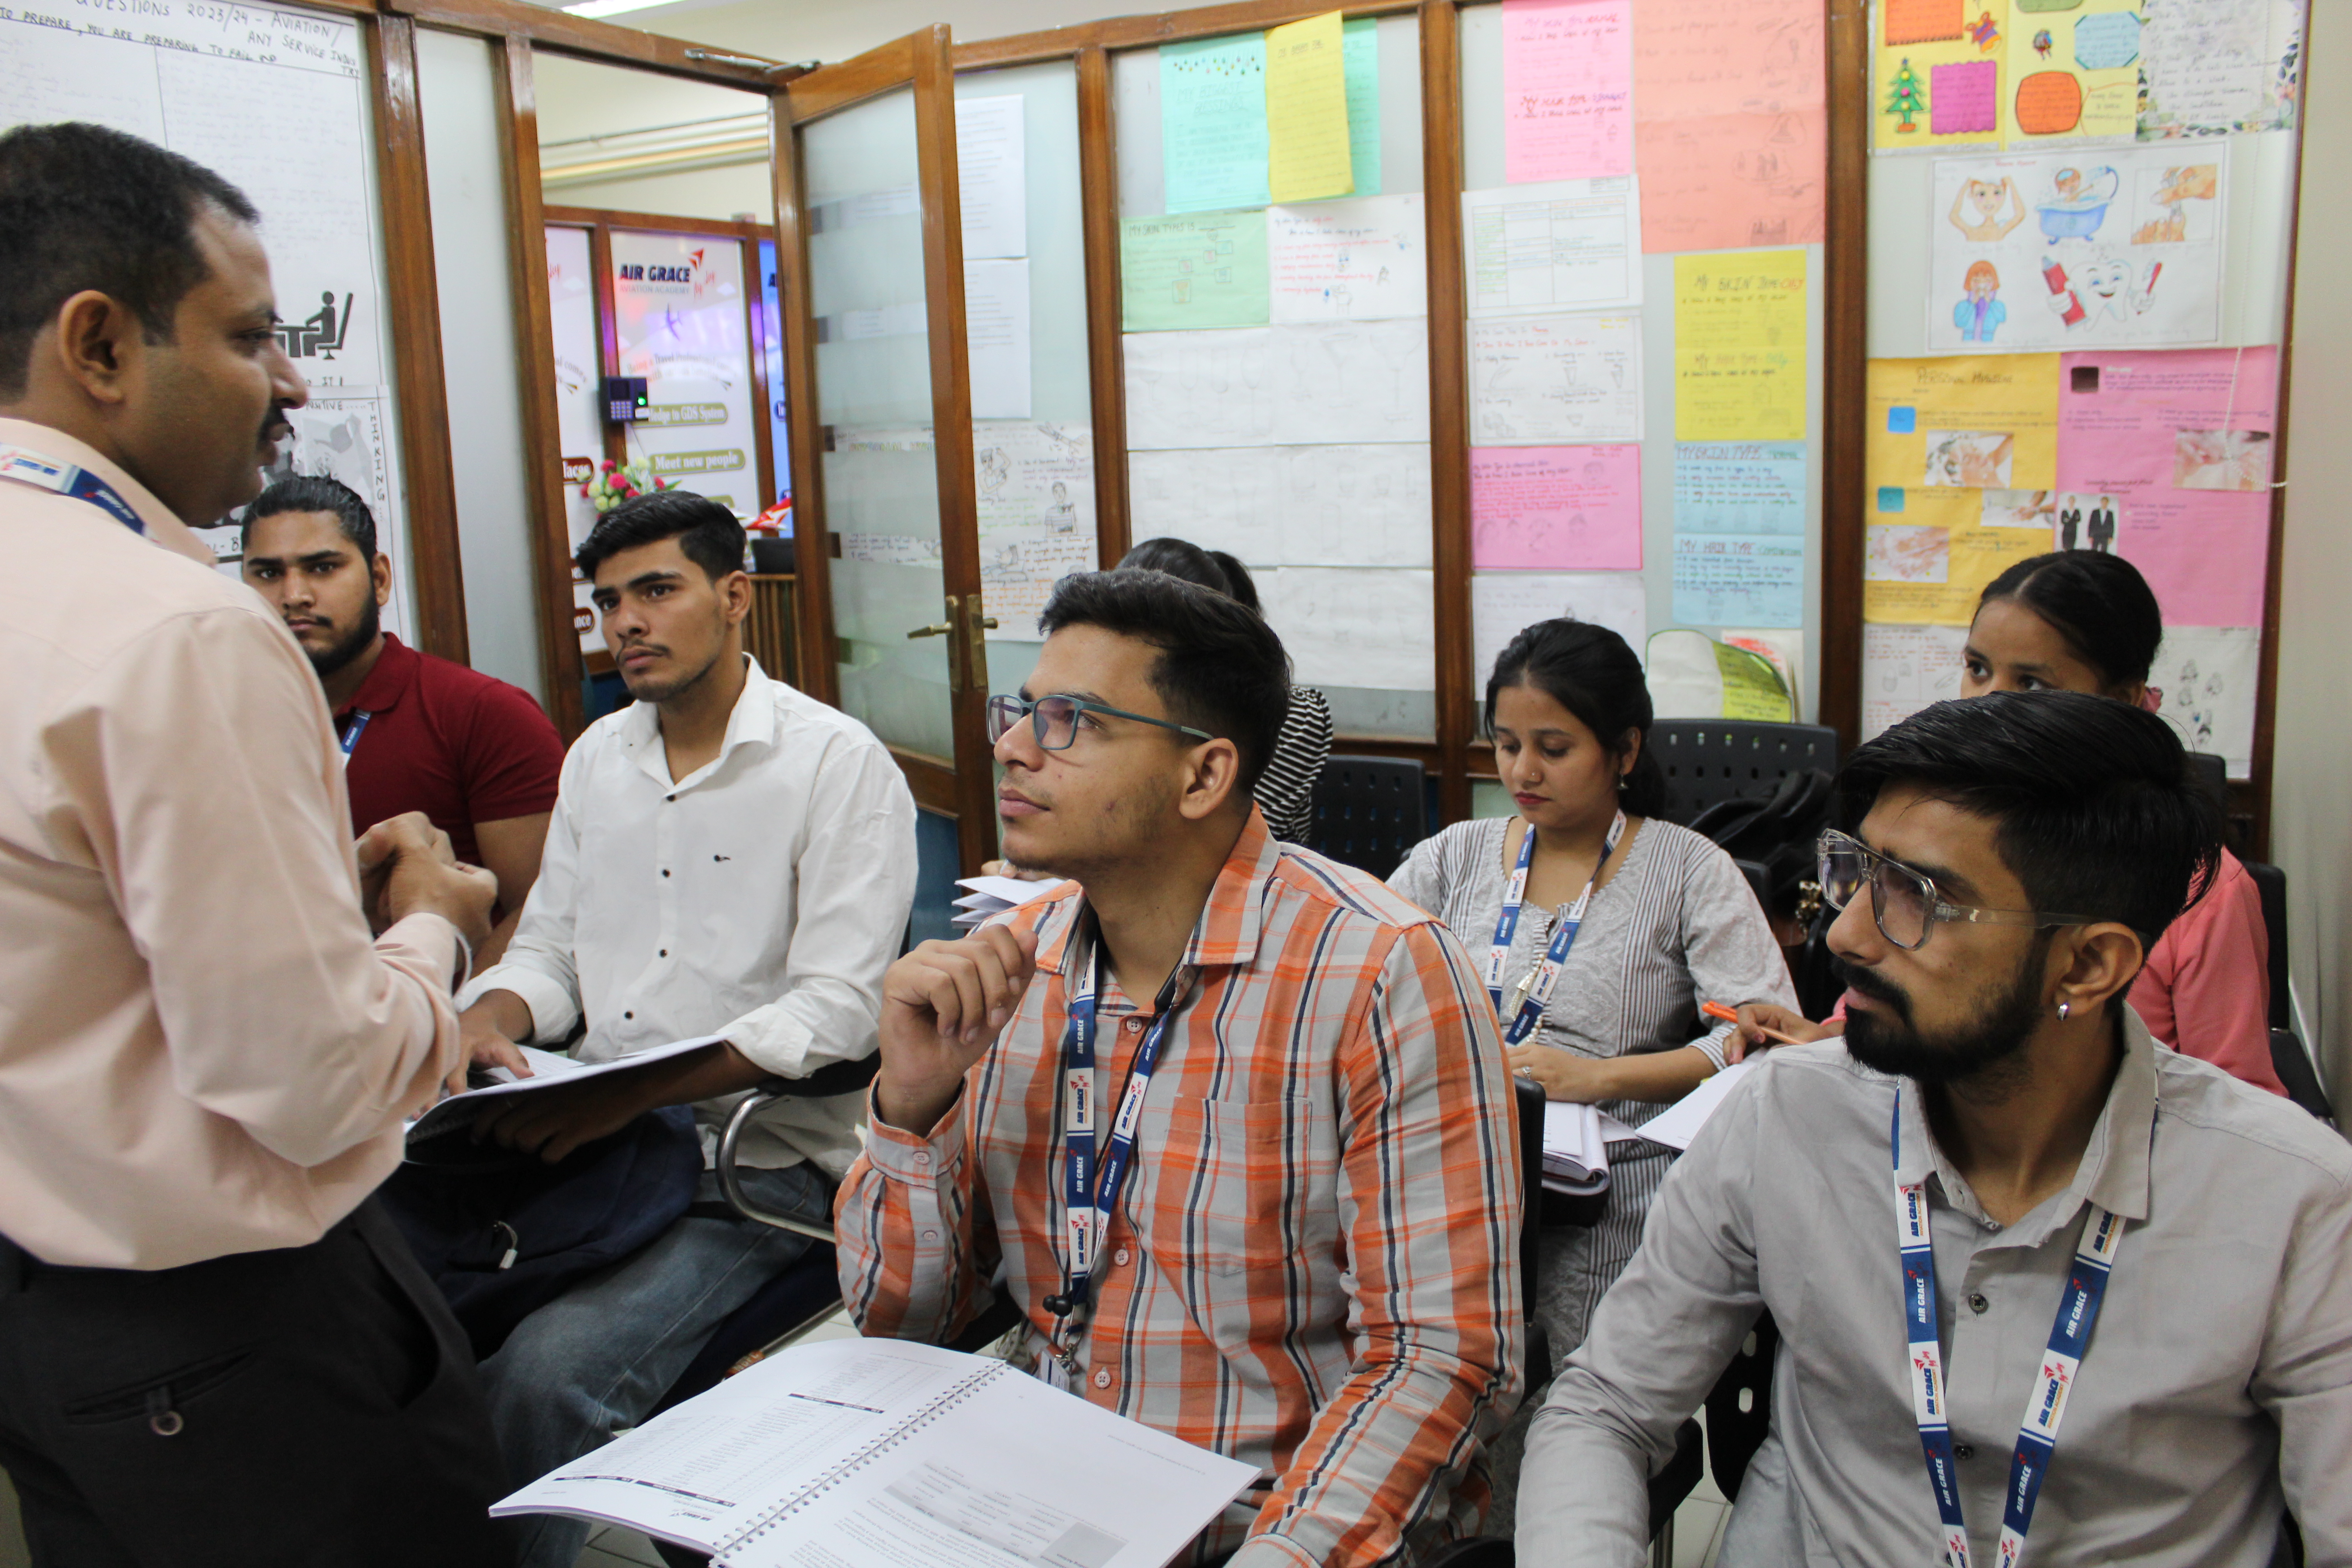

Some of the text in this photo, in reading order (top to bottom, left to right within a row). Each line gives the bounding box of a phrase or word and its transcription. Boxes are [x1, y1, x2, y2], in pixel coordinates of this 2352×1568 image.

[186, 3, 248, 32] 2023/24
[87, 23, 104, 36] YOU
[112, 28, 132, 41] ARE
[209, 44, 223, 55] TO
[247, 30, 272, 46] ANY
[282, 34, 325, 59] SERVICE
[1129, 225, 1140, 236] MY
[619, 264, 691, 282] AIR GRACE
[619, 284, 690, 294] AVIATION ACADEMY
[654, 352, 674, 363] Travel
[564, 361, 587, 384] comes
[672, 406, 725, 422] to GDS System
[655, 451, 739, 470] Meet new people
[1681, 539, 1697, 554] MY
[1558, 932, 1568, 946] GRACE
[1148, 1027, 1162, 1048] GRACE
[1124, 1094, 1137, 1116] GRACE
[1107, 1160, 1117, 1182] GRACE
[1911, 1223, 1920, 1238] AIR
[2093, 1234, 2105, 1253] AIR
[1916, 1278, 1927, 1324] AIR GRACE
[2065, 1290, 2087, 1338] AIR GRACE
[1924, 1368, 1936, 1415] AIR GRACE
[2038, 1378, 2059, 1427] AIR GRACE
[2047, 1384, 2064, 1429] AVIATION ACADEMY
[1935, 1458, 1950, 1490] GRACE
[914, 1486, 928, 1495] France
[2016, 1465, 2032, 1514] AIR GRACE
[957, 1509, 991, 1526] American Airlines
[967, 1504, 996, 1519] British Airways
[1035, 1508, 1064, 1523] United Airlines
[1008, 1522, 1049, 1543] Scandinavian Airlines
[1010, 1532, 1024, 1541] Canada
